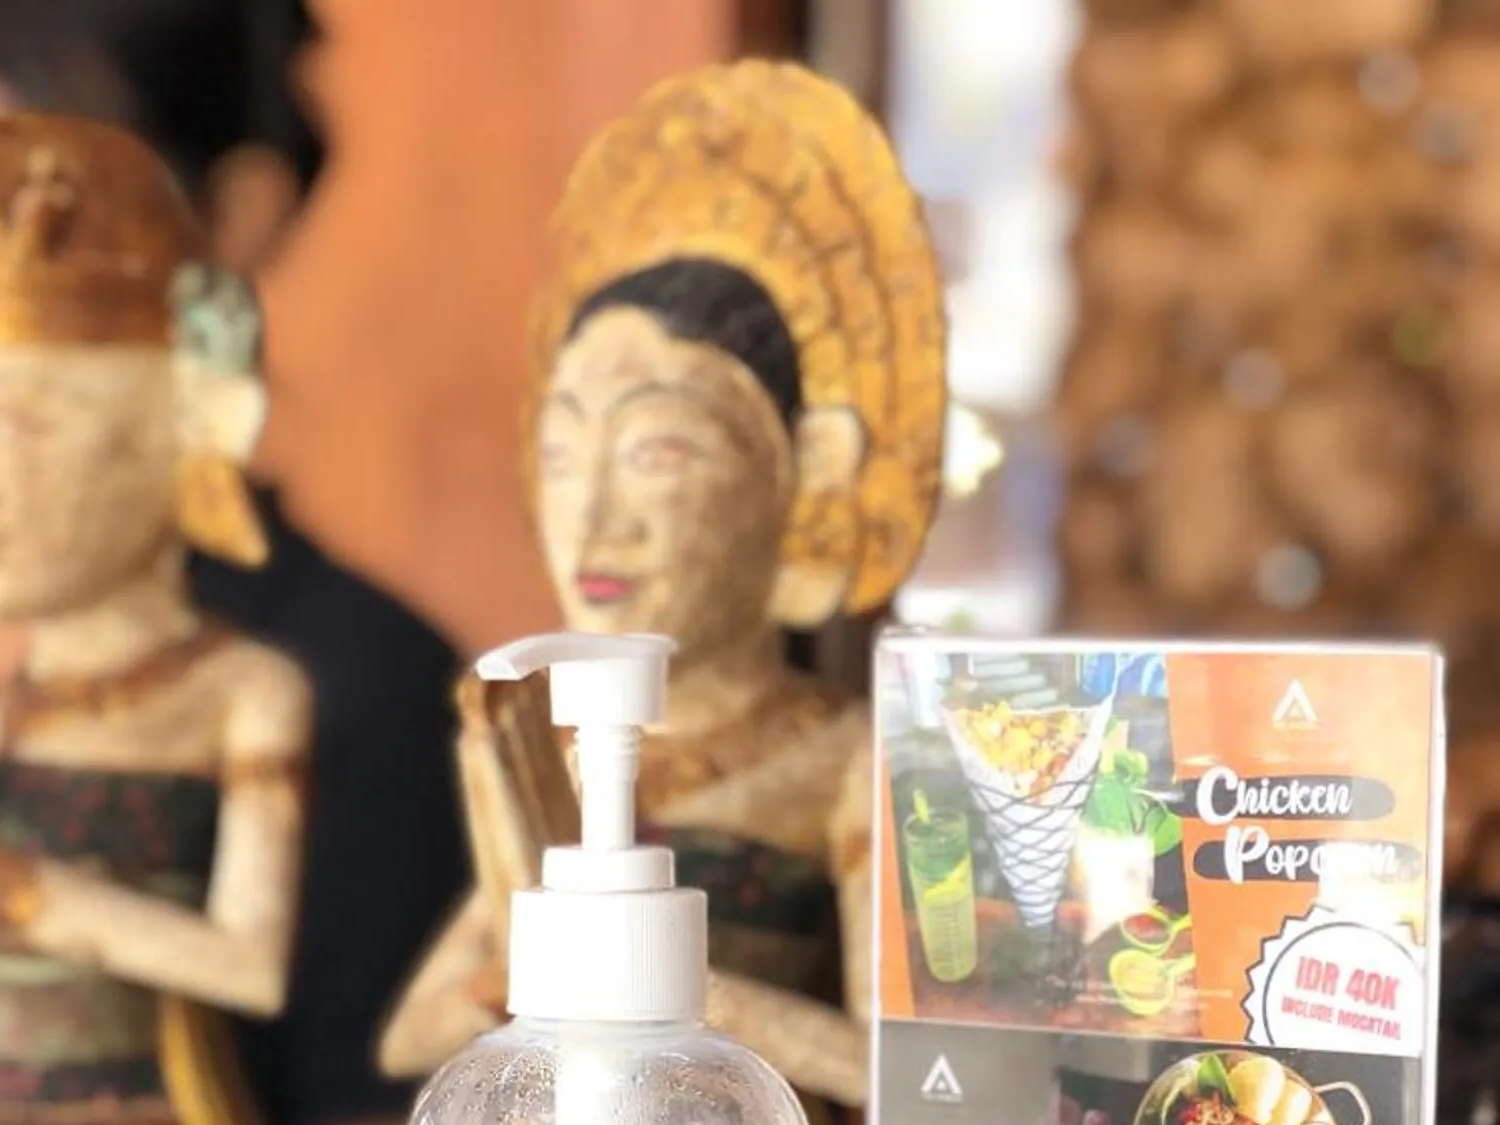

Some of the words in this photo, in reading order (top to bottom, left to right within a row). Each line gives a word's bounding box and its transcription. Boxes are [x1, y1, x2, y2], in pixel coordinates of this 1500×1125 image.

[1196, 766, 1352, 825] Chicken
[1296, 956, 1339, 996] IDR
[1346, 968, 1400, 1010] 40K
